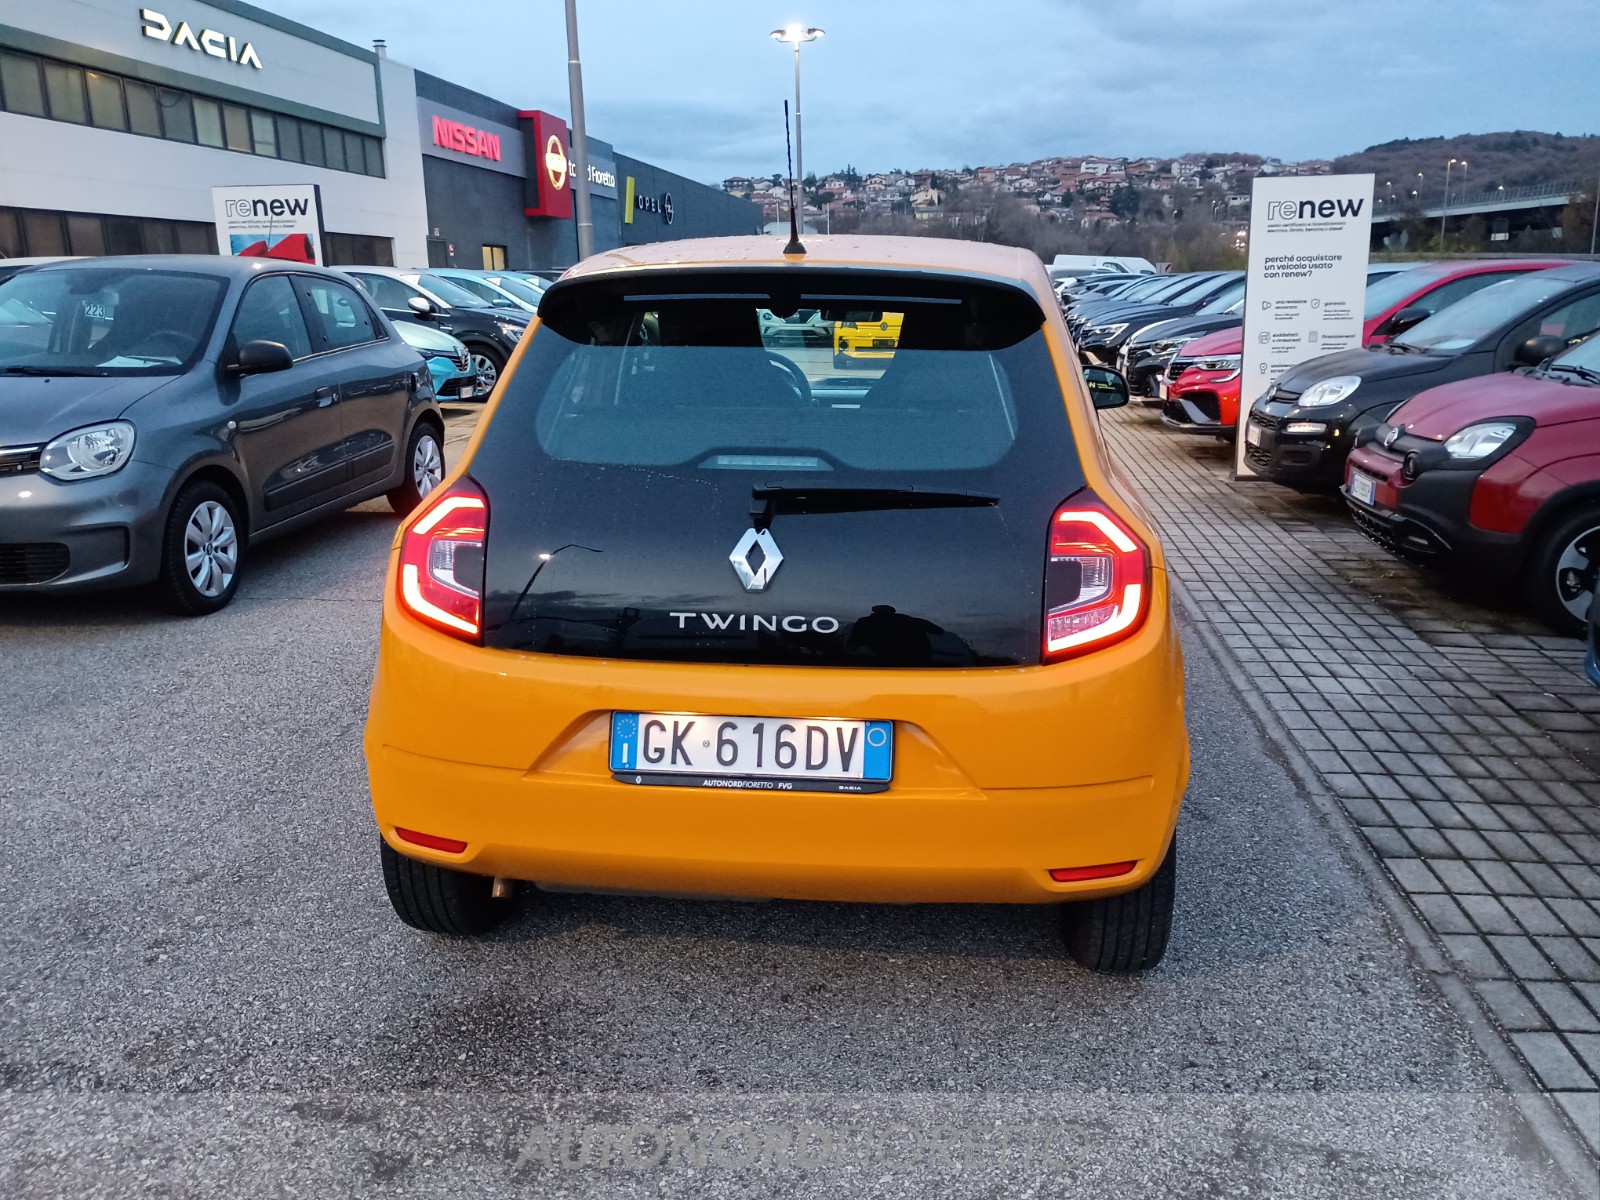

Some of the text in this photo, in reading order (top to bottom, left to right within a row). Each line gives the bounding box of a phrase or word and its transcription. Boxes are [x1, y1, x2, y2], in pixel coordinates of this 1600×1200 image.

[139, 8, 262, 69] DACIA
[432, 115, 501, 162] NISSAN
[225, 198, 309, 217] renew
[638, 195, 661, 213] OPEL
[1267, 198, 1364, 220] renew
[1265, 253, 1342, 264] perché acquistare
[1277, 262, 1307, 270] veicolo
[1281, 270, 1312, 278] renew?
[86, 304, 104, 317] 223
[669, 611, 839, 633] TWINGO
[643, 719, 696, 766] GK
[716, 721, 859, 772] 616DV
[778, 782, 793, 790] FVG
